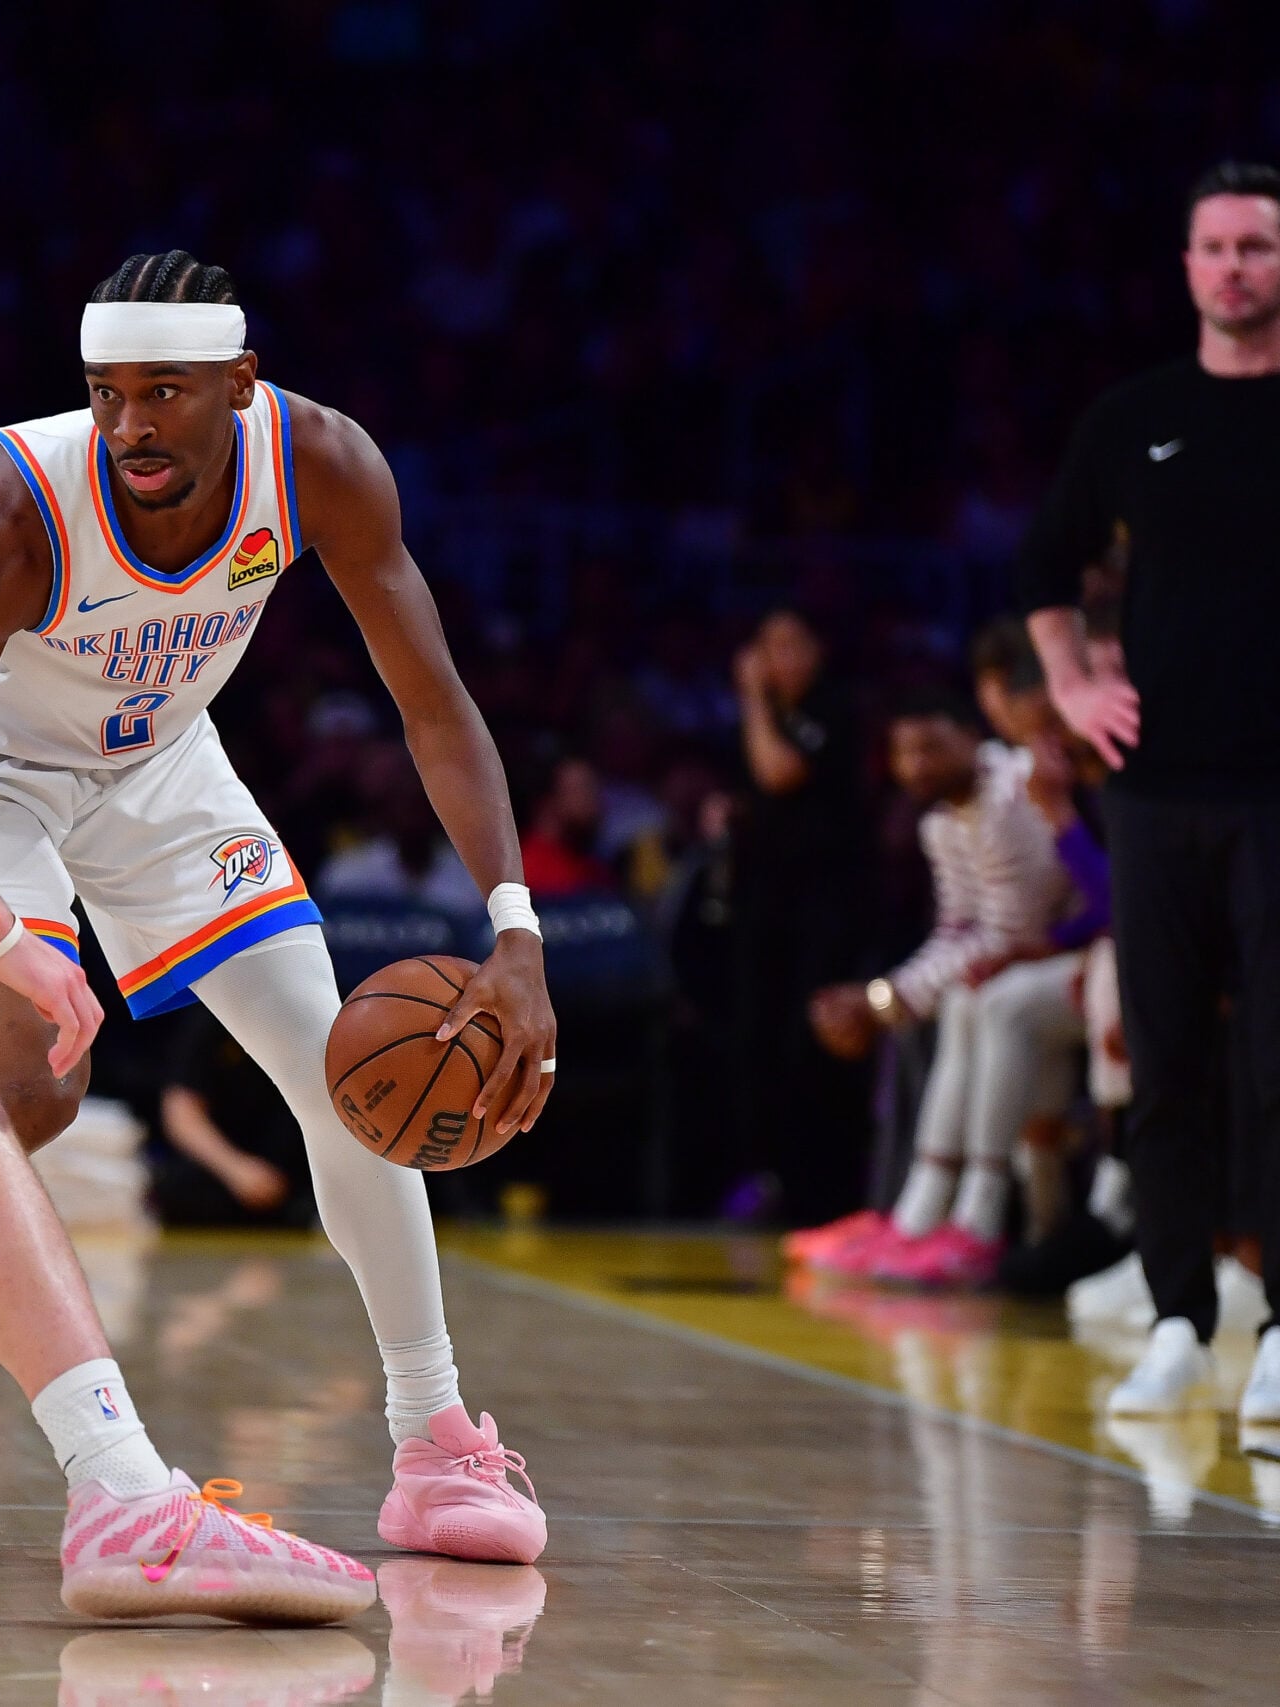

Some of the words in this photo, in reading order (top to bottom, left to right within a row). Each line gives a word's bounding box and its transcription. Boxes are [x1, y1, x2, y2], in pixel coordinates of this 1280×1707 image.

[102, 652, 217, 687] CITY
[101, 690, 175, 756] 2
[224, 842, 261, 888] OKC
